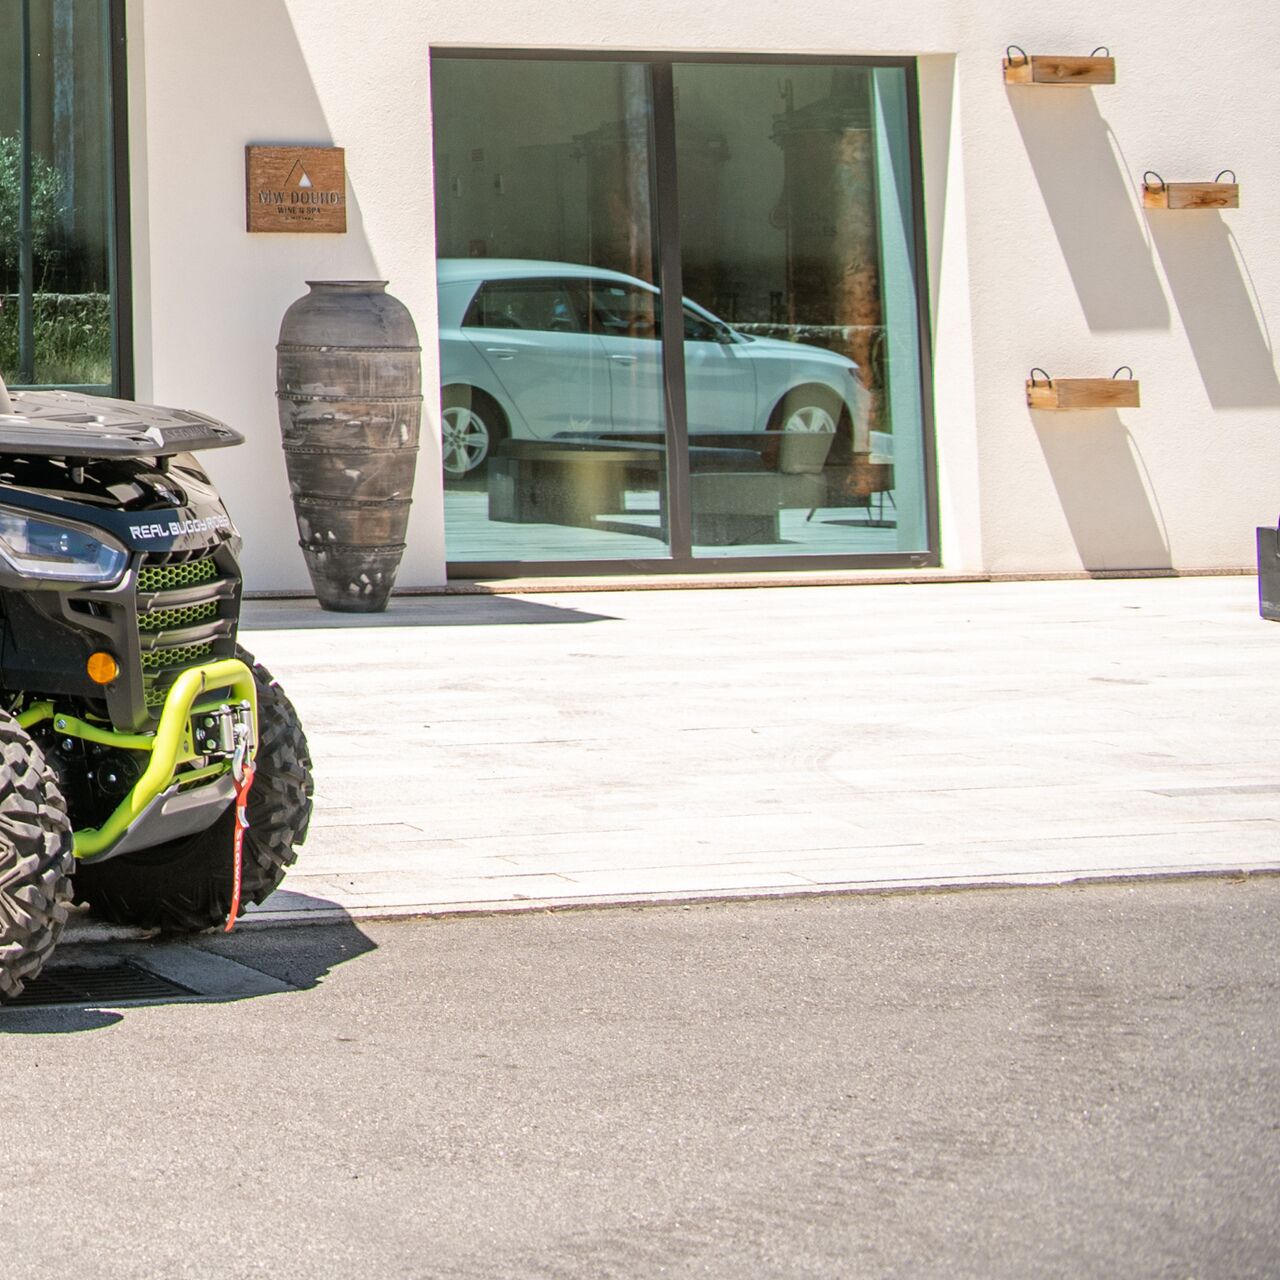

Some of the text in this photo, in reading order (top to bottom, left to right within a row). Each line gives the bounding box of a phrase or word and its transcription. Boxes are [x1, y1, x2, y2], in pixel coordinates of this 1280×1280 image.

[277, 207, 297, 215] WINE
[306, 207, 321, 215] SPA
[129, 522, 170, 540] REAL
[168, 518, 208, 536] BUGGY
